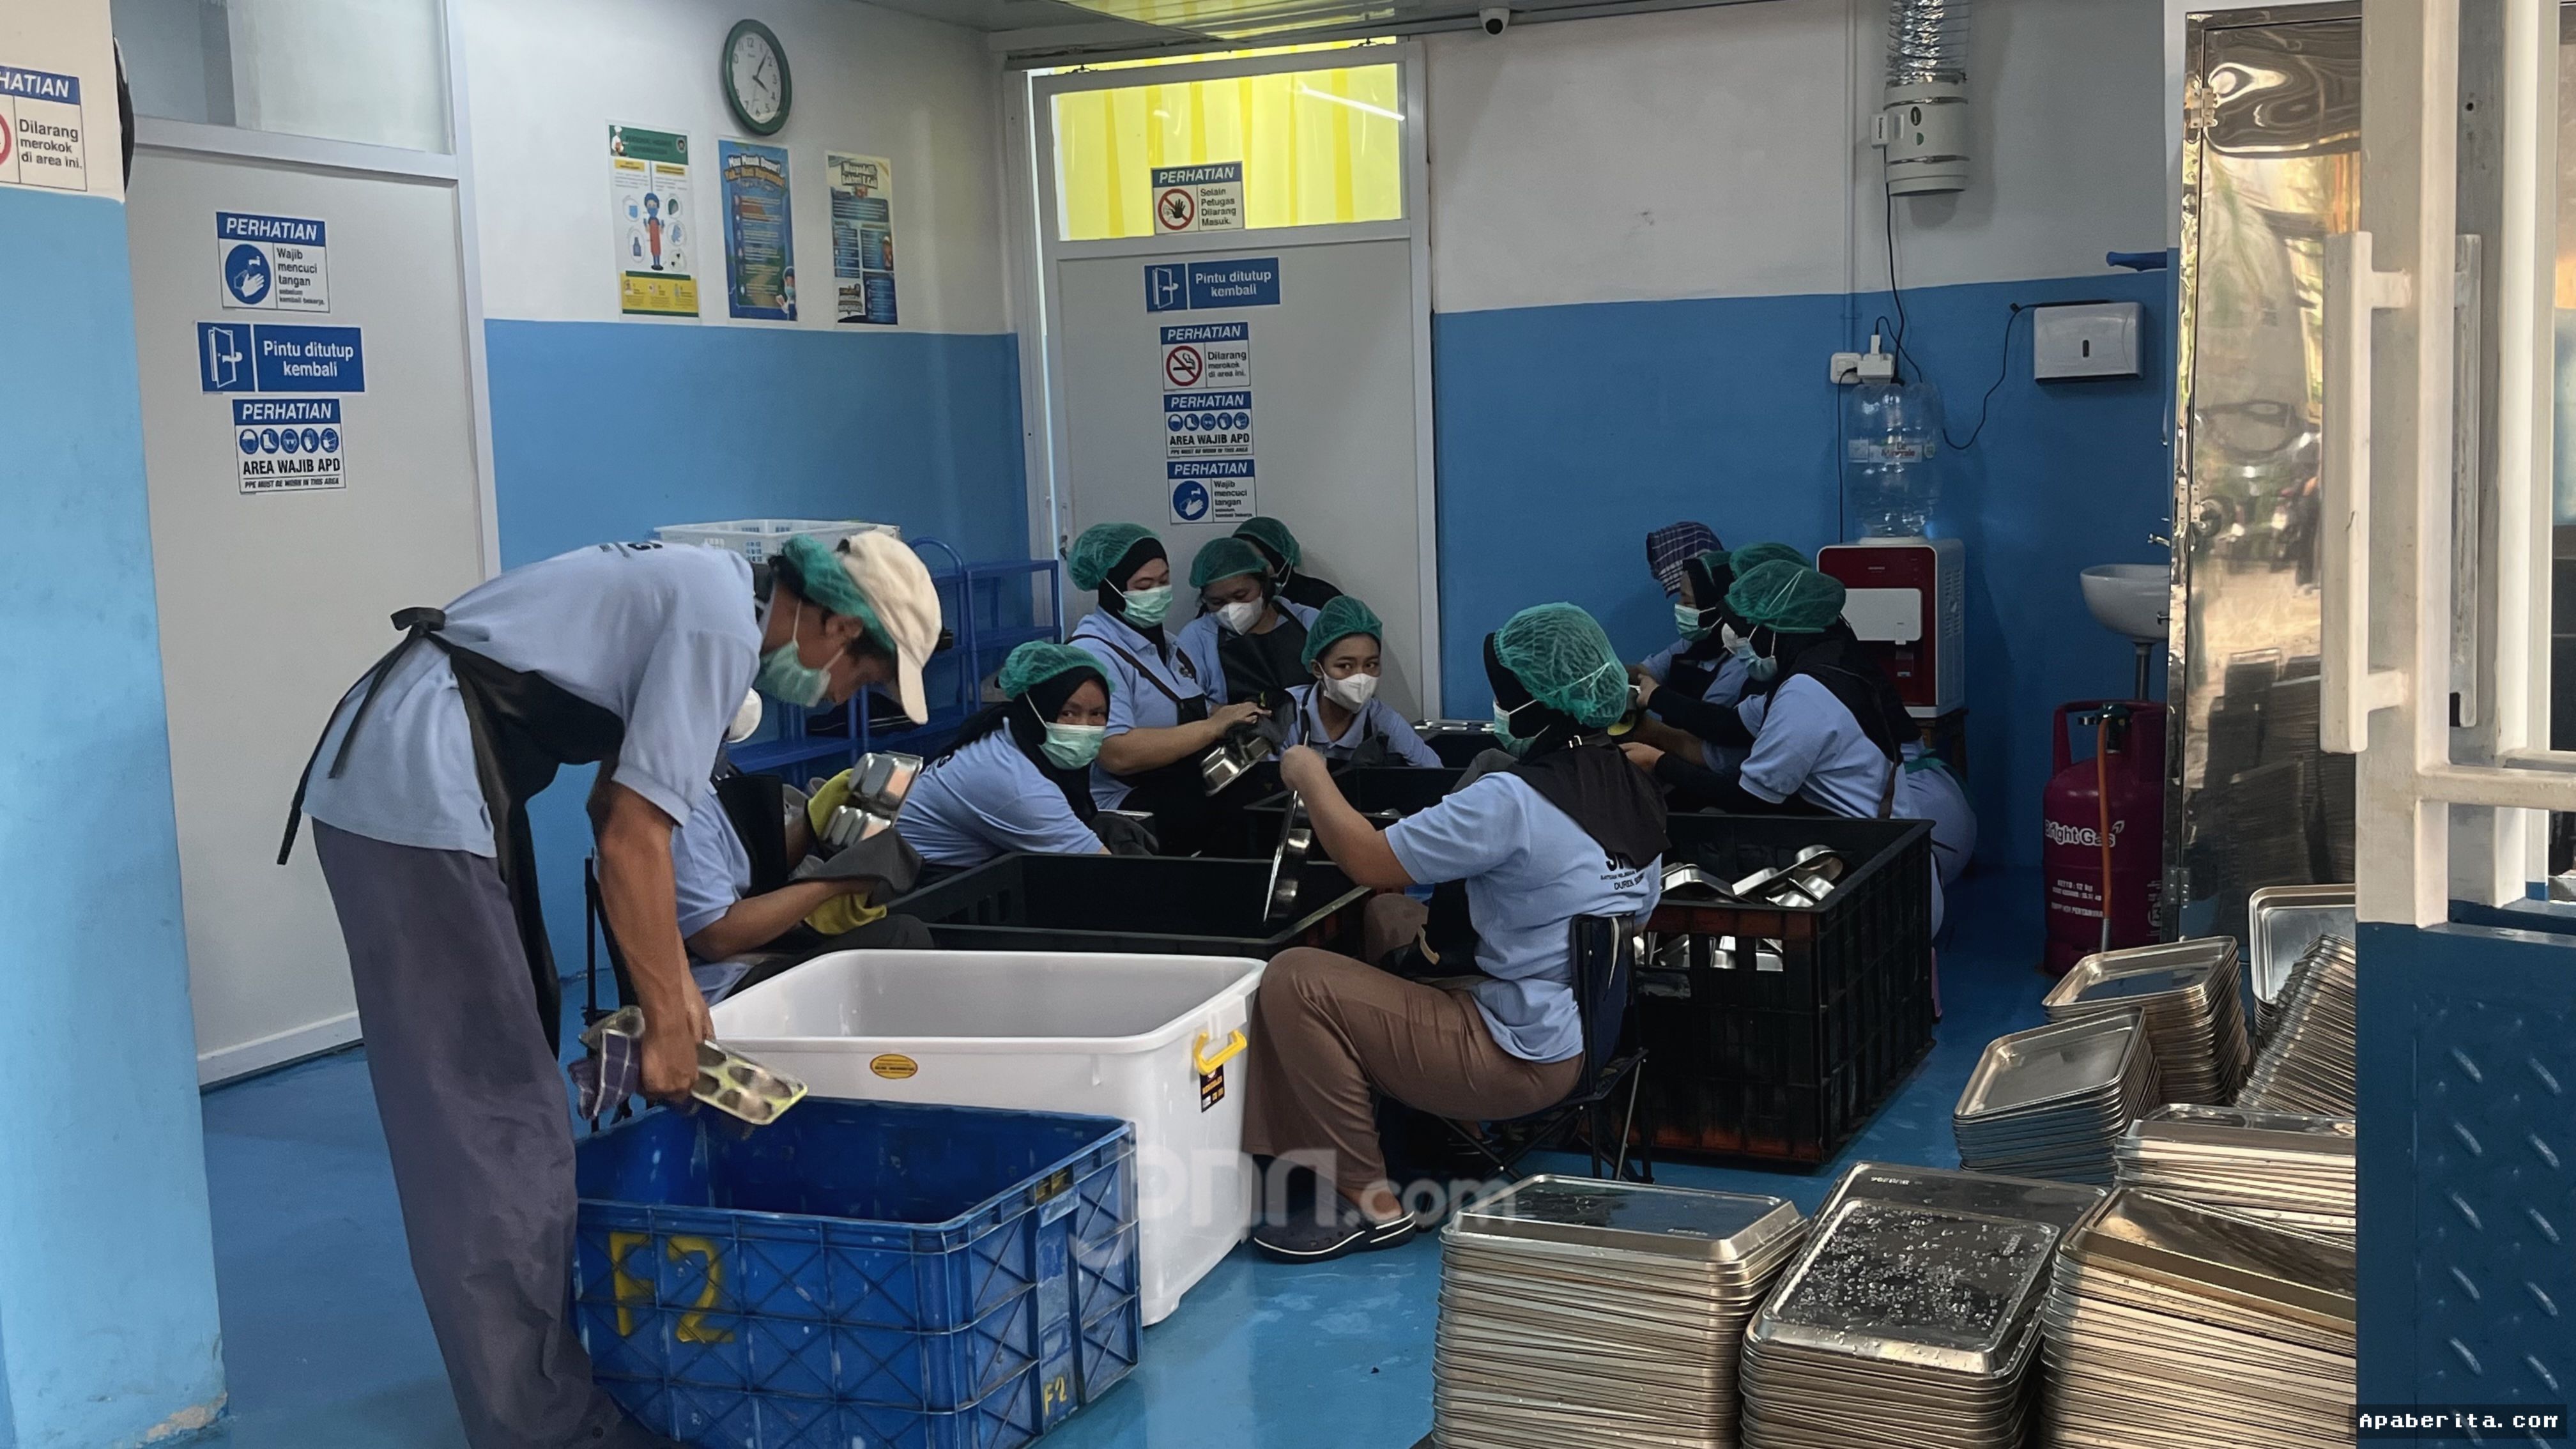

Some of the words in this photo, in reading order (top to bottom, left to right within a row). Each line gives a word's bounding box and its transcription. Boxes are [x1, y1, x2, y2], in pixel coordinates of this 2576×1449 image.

[19, 118, 79, 142] Dilarang
[20, 138, 72, 153] merokok
[21, 151, 33, 163] di
[36, 155, 62, 166] area
[65, 156, 82, 169] ini.
[1159, 166, 1235, 184] PERHATIAN
[1200, 188, 1226, 197] Selain
[1200, 198, 1235, 207] Petugas
[1201, 208, 1236, 217] Dilarang
[226, 217, 318, 241] PERHATIAN
[1202, 217, 1231, 227] Masuk.
[276, 247, 303, 262] Wajib
[277, 263, 318, 274] mencuci
[278, 275, 311, 288] tangan
[1195, 272, 1226, 284] Pintu
[1229, 270, 1271, 283] ditutup
[1211, 284, 1257, 297] kembali
[1167, 324, 1241, 341] PERHATIAN
[263, 340, 301, 357] Pintu
[305, 342, 354, 362] ditutup
[1208, 351, 1247, 361] Dilarang
[282, 360, 338, 378] kembali
[1208, 361, 1240, 369] merokok
[1171, 394, 1244, 409] PERHATIAN
[242, 402, 332, 420] PERHATIAN
[1169, 435, 1195, 445] AREA
[1197, 434, 1227, 445] WAJIB
[1230, 433, 1250, 443] APD
[243, 460, 275, 475] AREA
[277, 459, 314, 474] WAJIB
[318, 457, 341, 472] APD
[1174, 461, 1248, 476] PERHATIAN
[1213, 480, 1236, 489] Wajib
[1215, 499, 1241, 507] tangan
[610, 1230, 735, 1343] F2
[1044, 1376, 1068, 1417] F2
